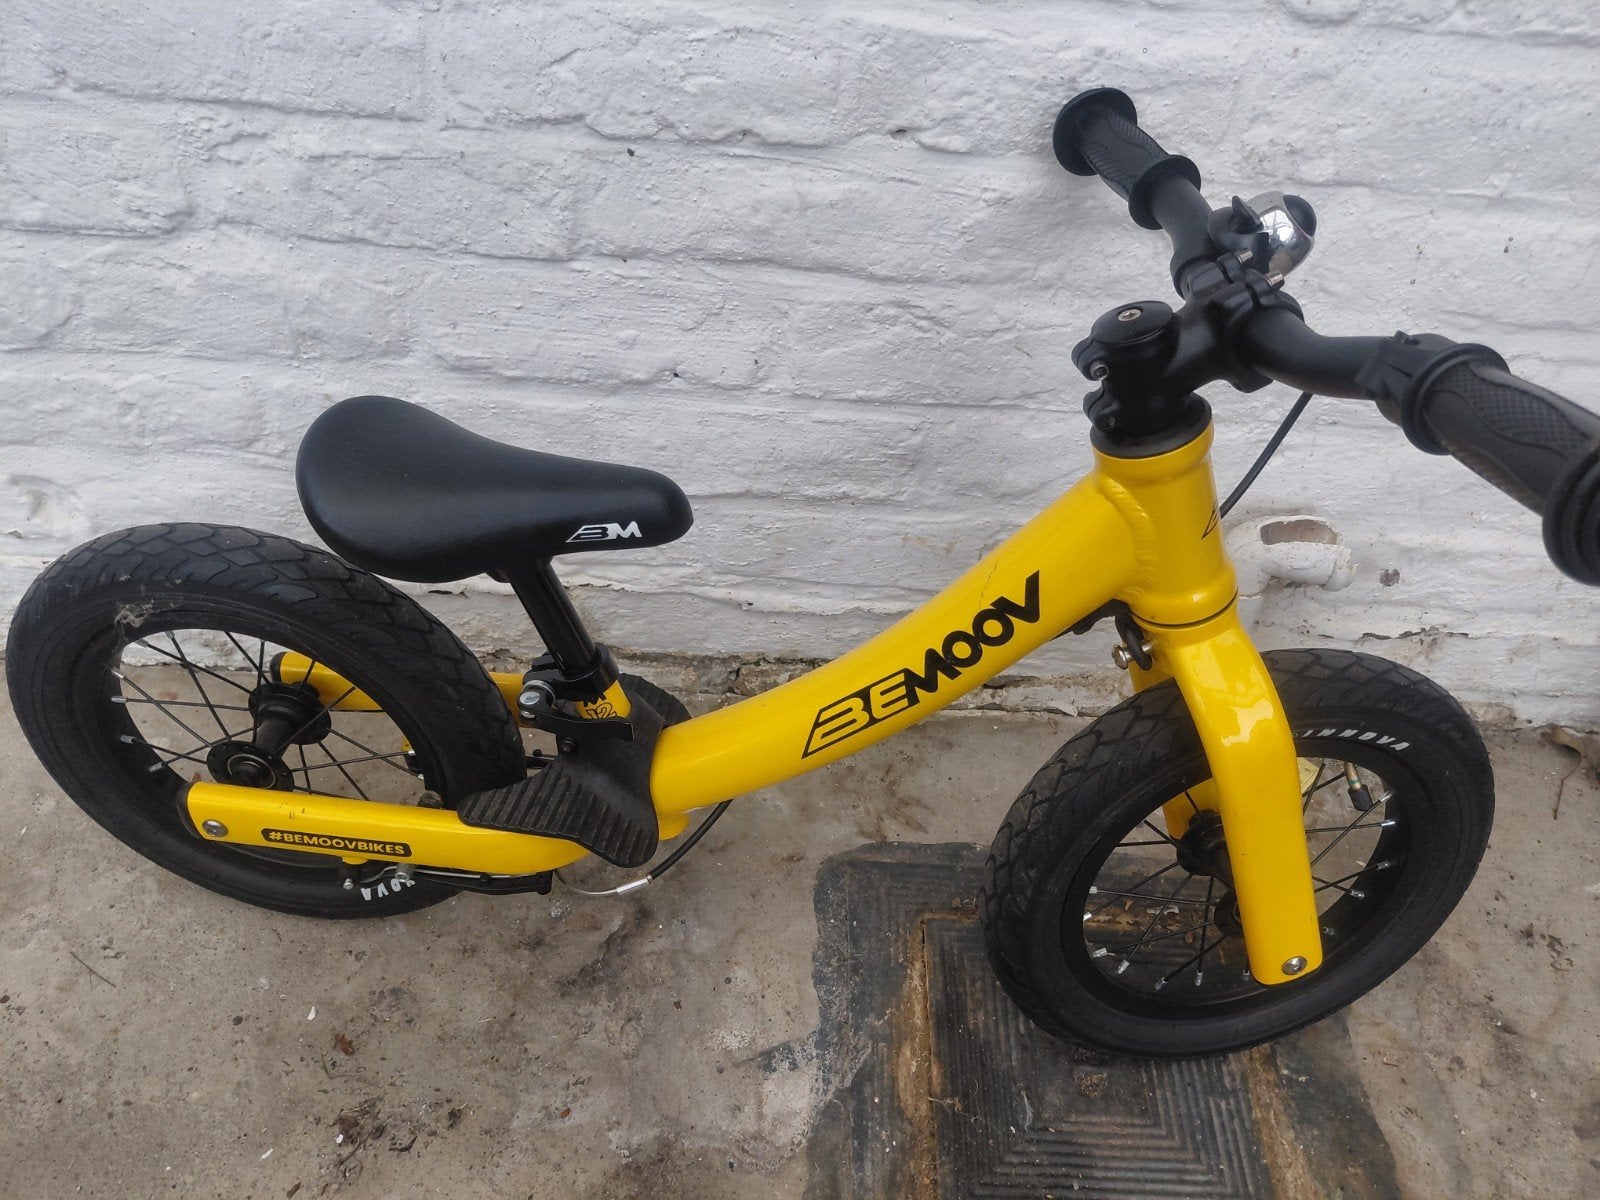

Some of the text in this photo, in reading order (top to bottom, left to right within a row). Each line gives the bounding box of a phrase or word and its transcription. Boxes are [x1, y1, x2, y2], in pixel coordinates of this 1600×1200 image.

[801, 569, 1040, 760] BEMOOV
[1301, 728, 1410, 751] INNOVA
[268, 830, 406, 855] #BEMOOVBIKES
